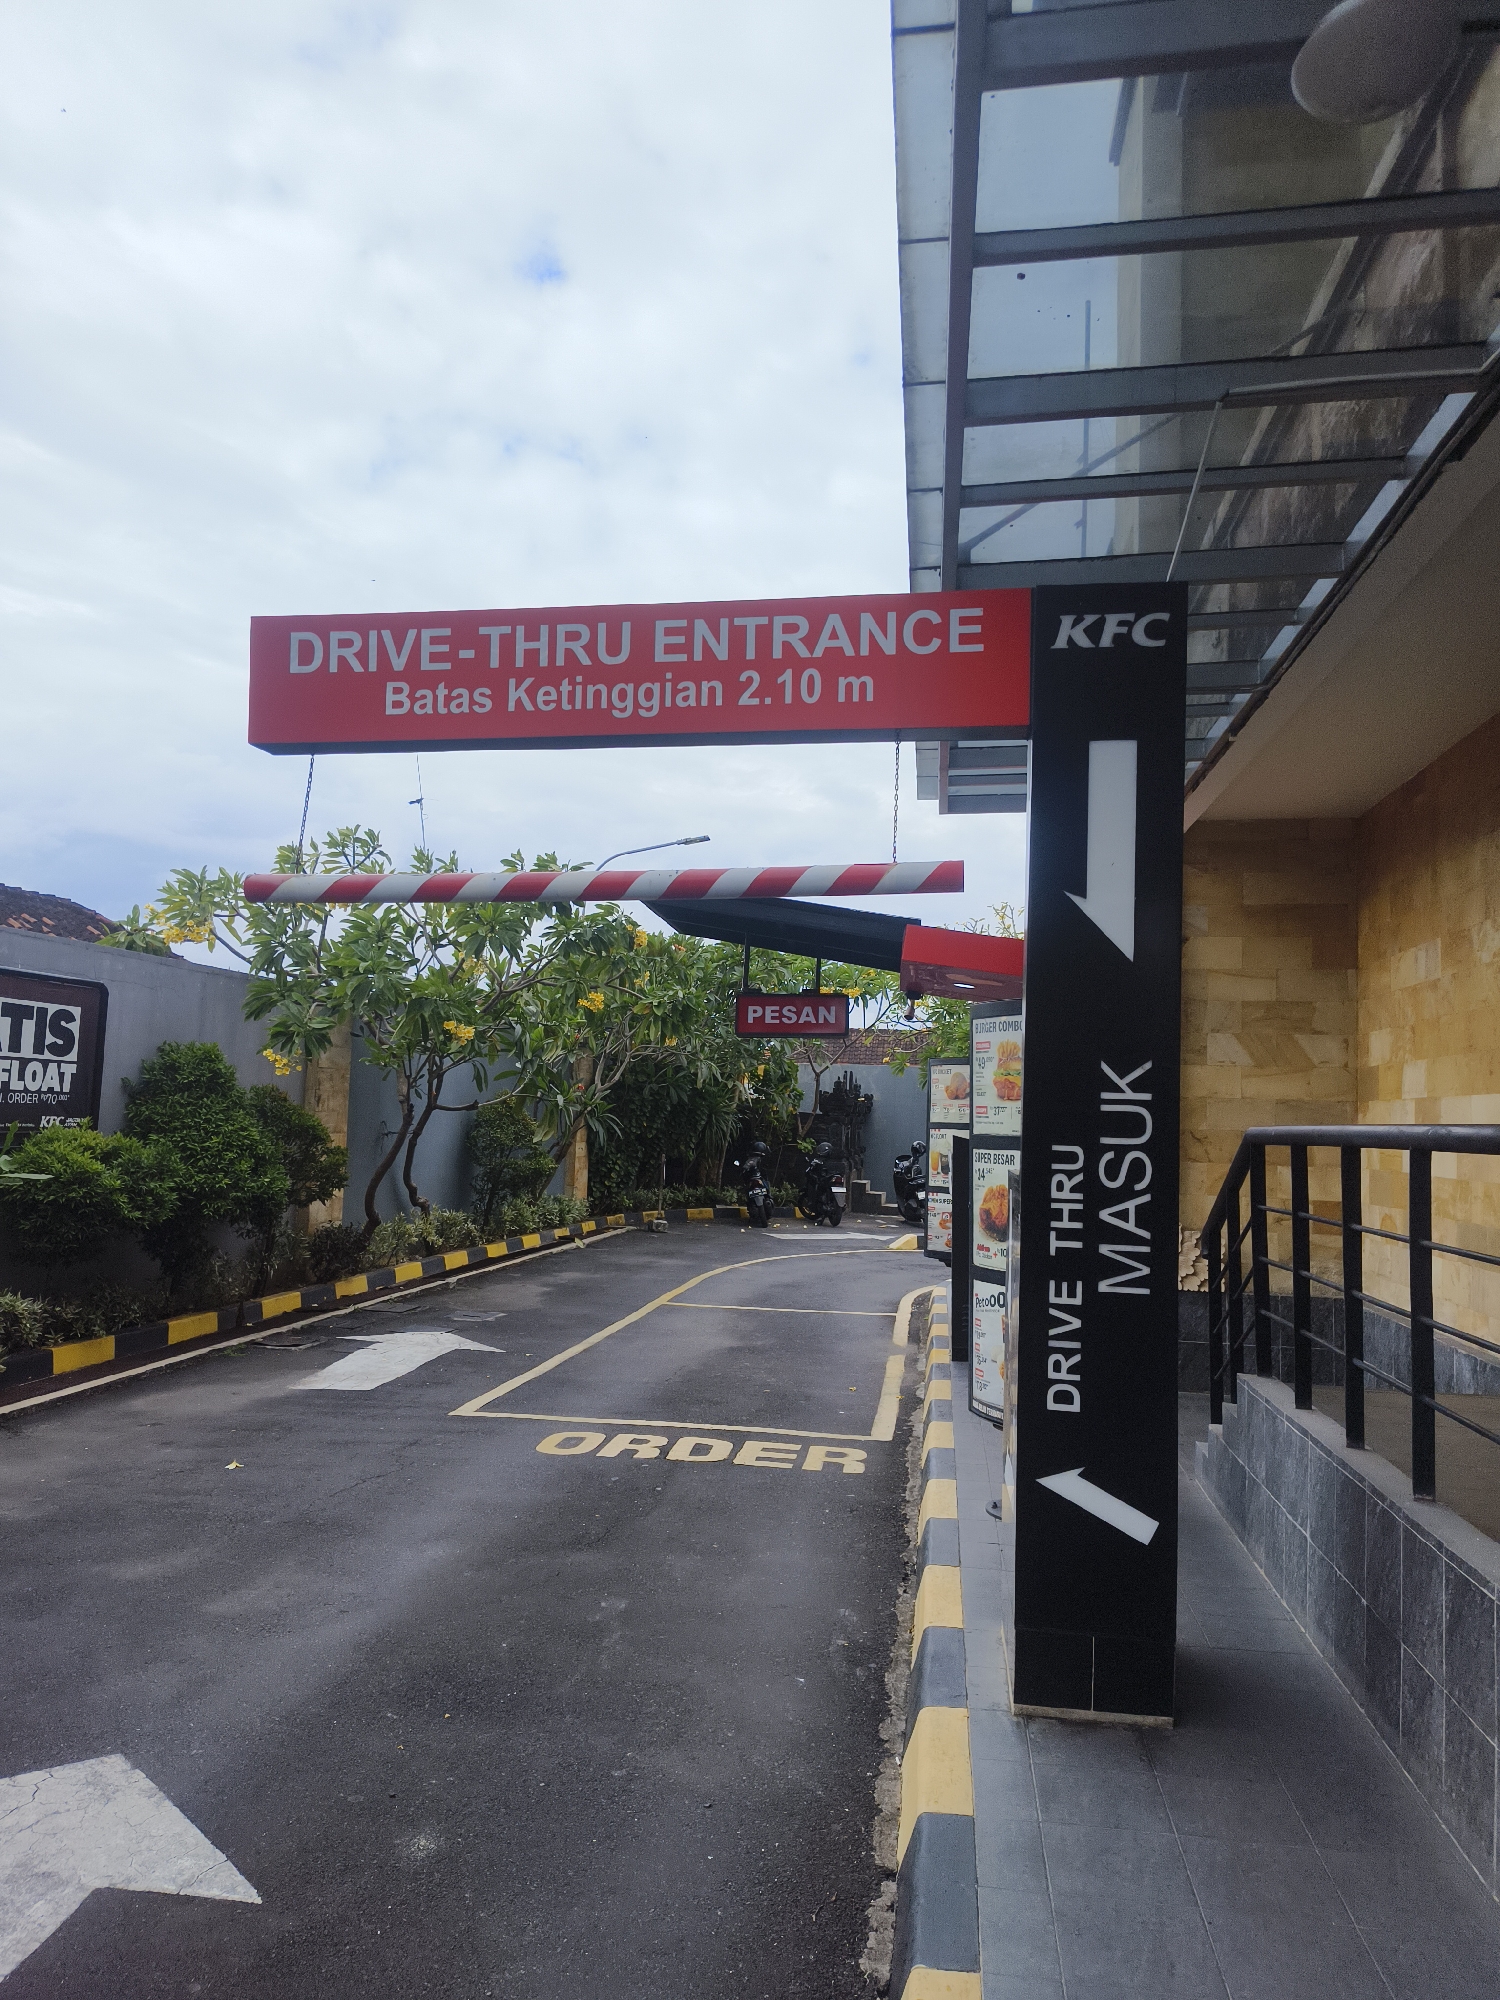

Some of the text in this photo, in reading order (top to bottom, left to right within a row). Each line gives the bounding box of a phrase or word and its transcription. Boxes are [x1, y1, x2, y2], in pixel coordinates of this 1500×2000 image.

[289, 607, 985, 674] DRIVE-THRU ENTRANCE
[1050, 612, 1171, 649] KFC
[385, 668, 874, 719] Batas Ketinggian 2.10 m
[0, 1001, 77, 1057] TIS
[747, 1005, 836, 1024] PESAN
[975, 1021, 997, 1034] BURGER
[0, 1060, 77, 1093] FLOAT
[8, 1092, 39, 1104] ORDER
[974, 1151, 1016, 1166] SUPER BESAR
[1098, 1060, 1153, 1295] MASUK
[1047, 1145, 1085, 1413] DRIVE THRU
[535, 1431, 868, 1474] ORDER
